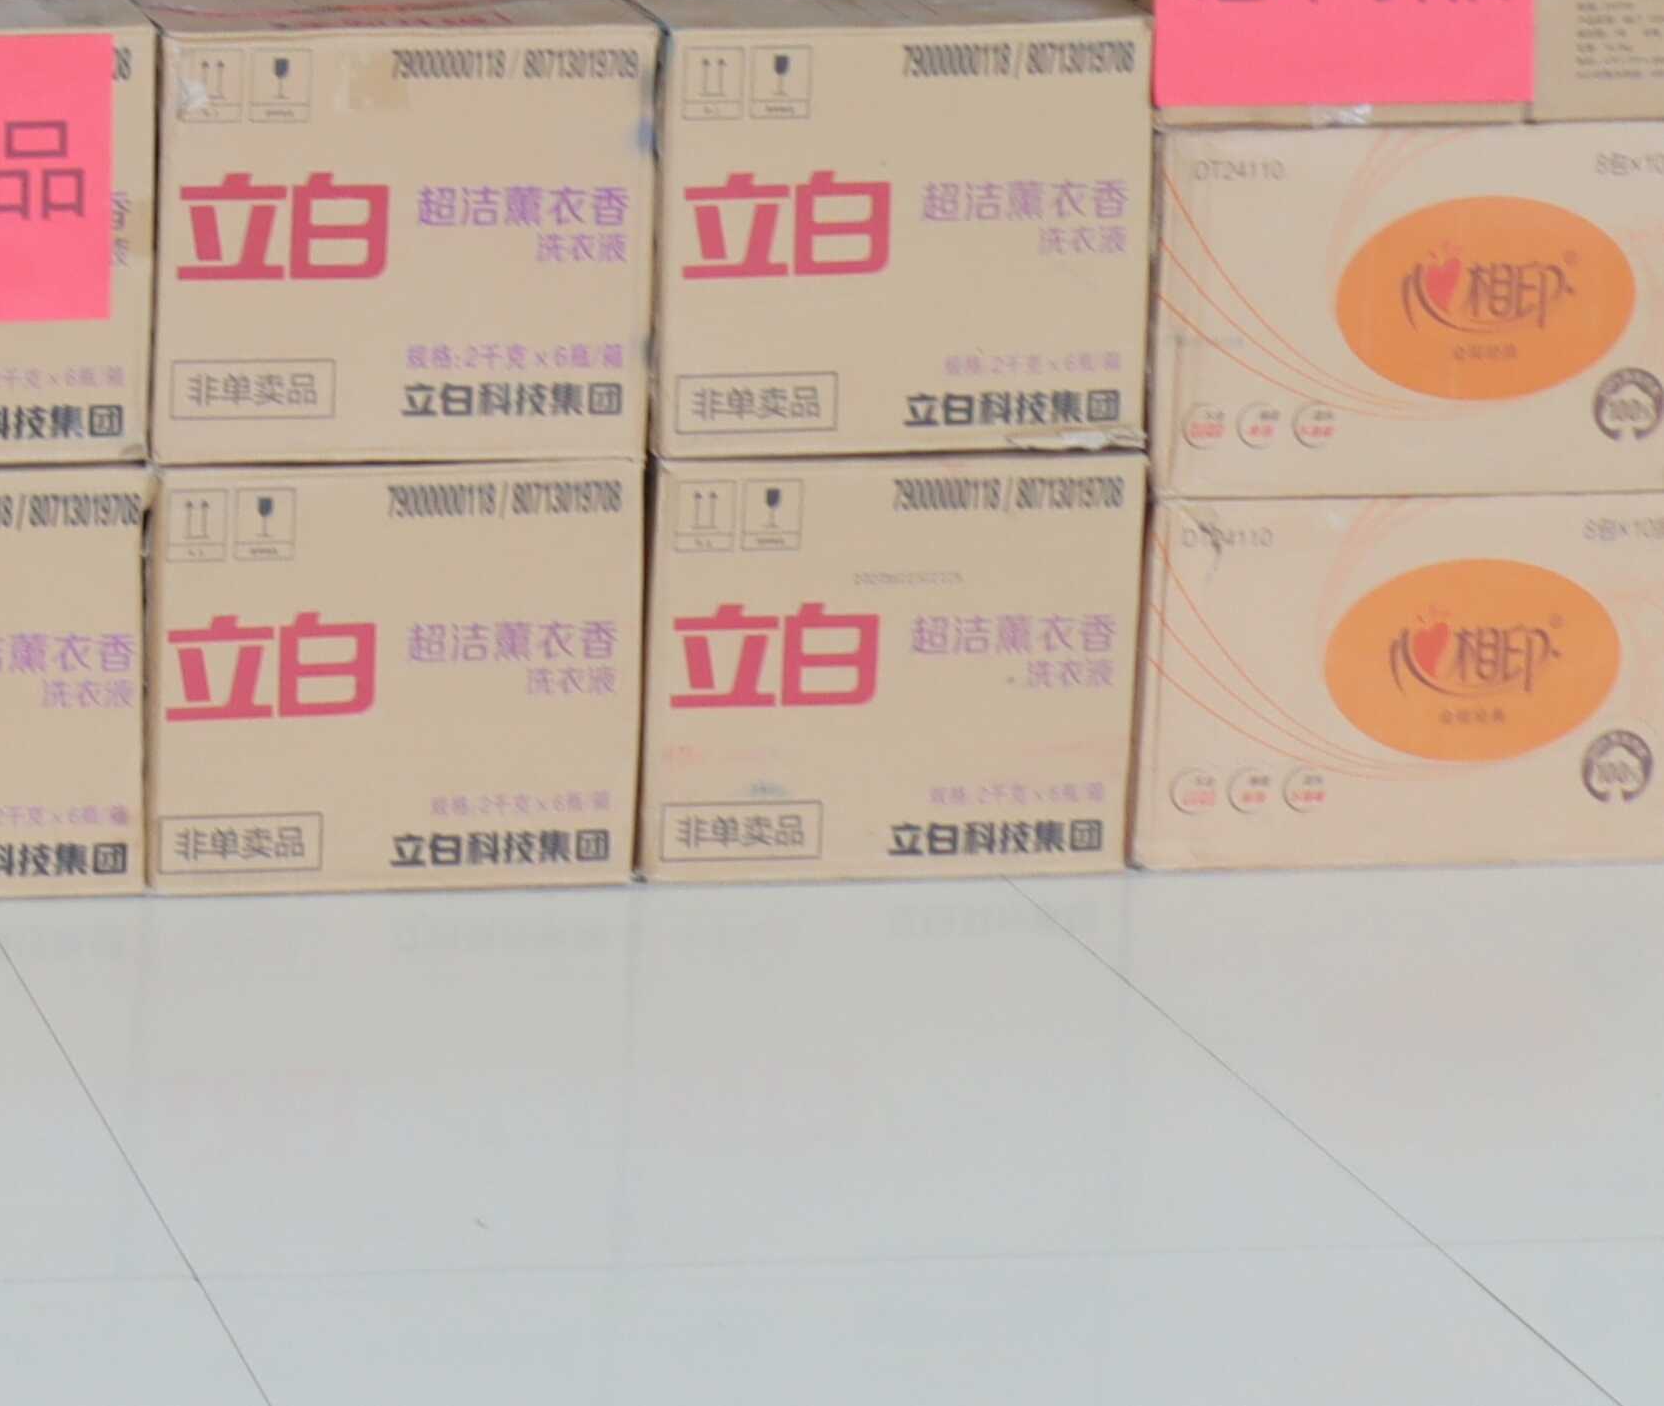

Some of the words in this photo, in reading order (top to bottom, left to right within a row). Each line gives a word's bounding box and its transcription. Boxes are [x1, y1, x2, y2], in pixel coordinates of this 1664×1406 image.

[418, 185, 628, 230] 超洁薰衣香
[922, 180, 1127, 224] 超洁薰衣香
[177, 172, 390, 281] 立白
[682, 170, 892, 280] 立白
[1039, 226, 1127, 254] 洗衣液
[536, 233, 626, 262] 洗衣液
[188, 373, 317, 410] 非单卖品
[402, 382, 623, 417] 立白科技集团
[693, 384, 822, 422] 非单卖品
[904, 389, 1120, 430] 立白科技集团
[409, 621, 616, 665] 超洁薰衣香
[911, 614, 1116, 656] 超洁薰衣香
[166, 611, 377, 722] 立白
[670, 602, 880, 709] 立白
[1027, 659, 1114, 688] 洗衣液
[43, 681, 135, 712] 洗衣液
[526, 665, 616, 695] 洗衣液
[175, 825, 306, 863] 非单卖品
[391, 829, 610, 867] 立白科技集团
[677, 814, 807, 852] 非单卖品
[889, 819, 1103, 856] 立白科技集团
